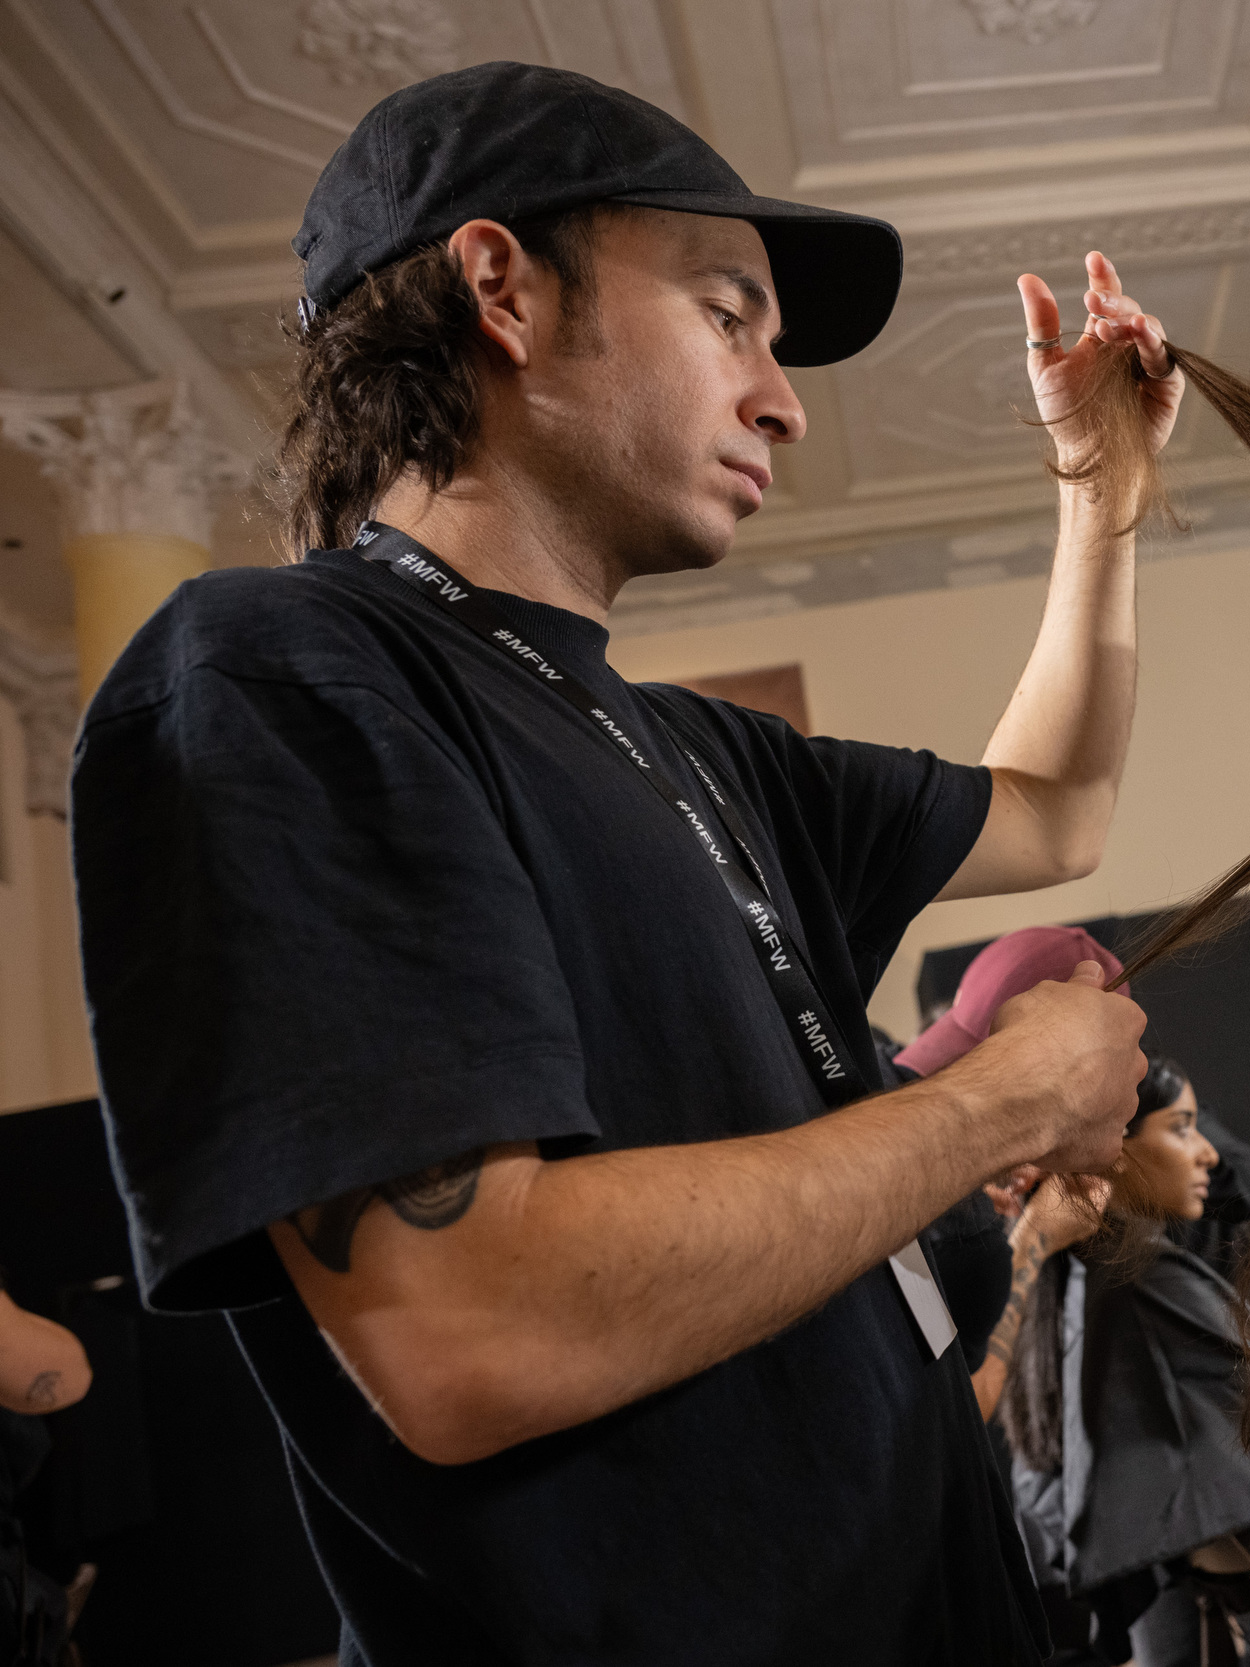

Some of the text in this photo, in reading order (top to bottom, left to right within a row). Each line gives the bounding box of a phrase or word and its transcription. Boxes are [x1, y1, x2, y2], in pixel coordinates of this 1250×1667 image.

[397, 553, 469, 602] #MFW
[493, 629, 564, 680] #MFW
[590, 708, 650, 768] #MFW
[676, 800, 728, 864] #MFW
[747, 900, 791, 971] #MFW
[798, 1010, 846, 1080] #MFW
